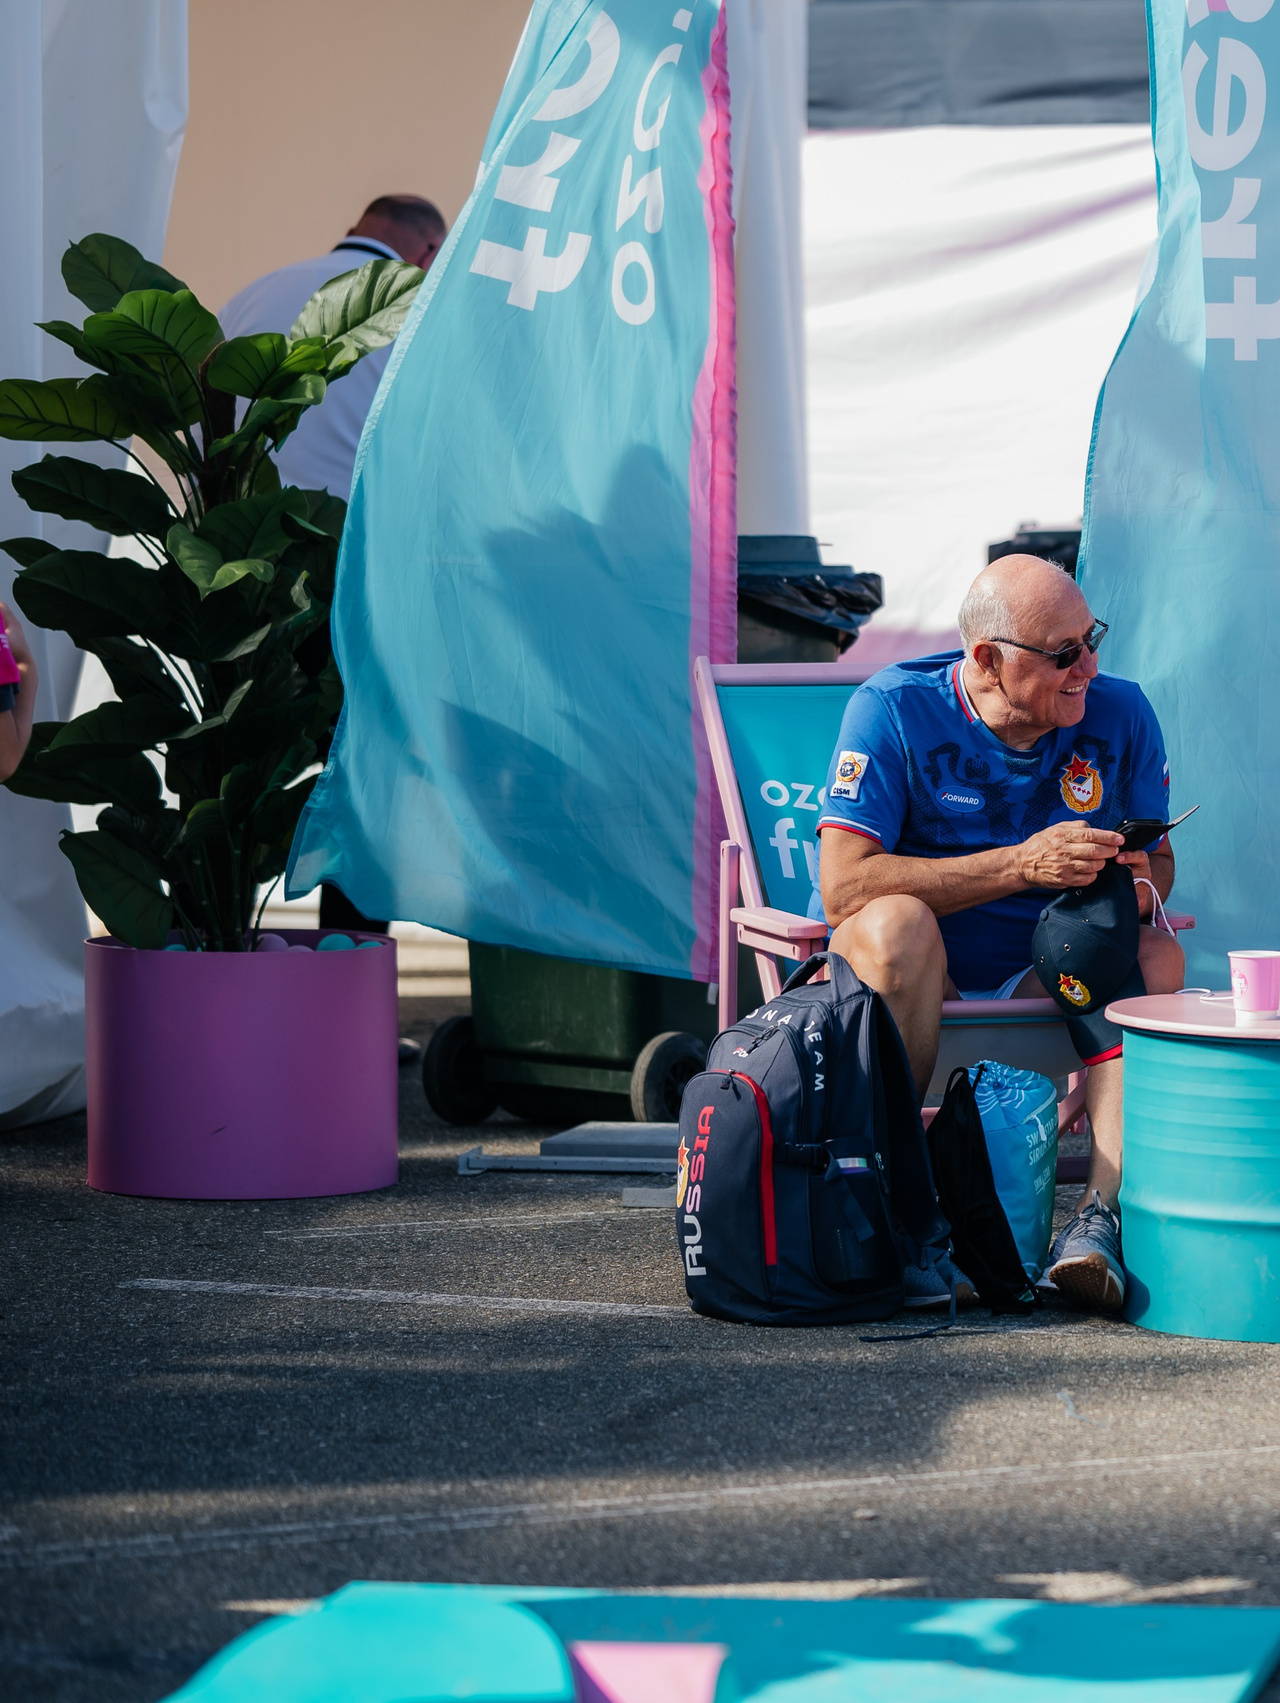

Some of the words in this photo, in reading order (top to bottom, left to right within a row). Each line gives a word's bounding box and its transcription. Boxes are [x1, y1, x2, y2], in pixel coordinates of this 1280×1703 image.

[833, 787, 850, 796] CISM
[942, 792, 979, 805] FORWARD
[684, 1105, 715, 1276] RUSSIA
